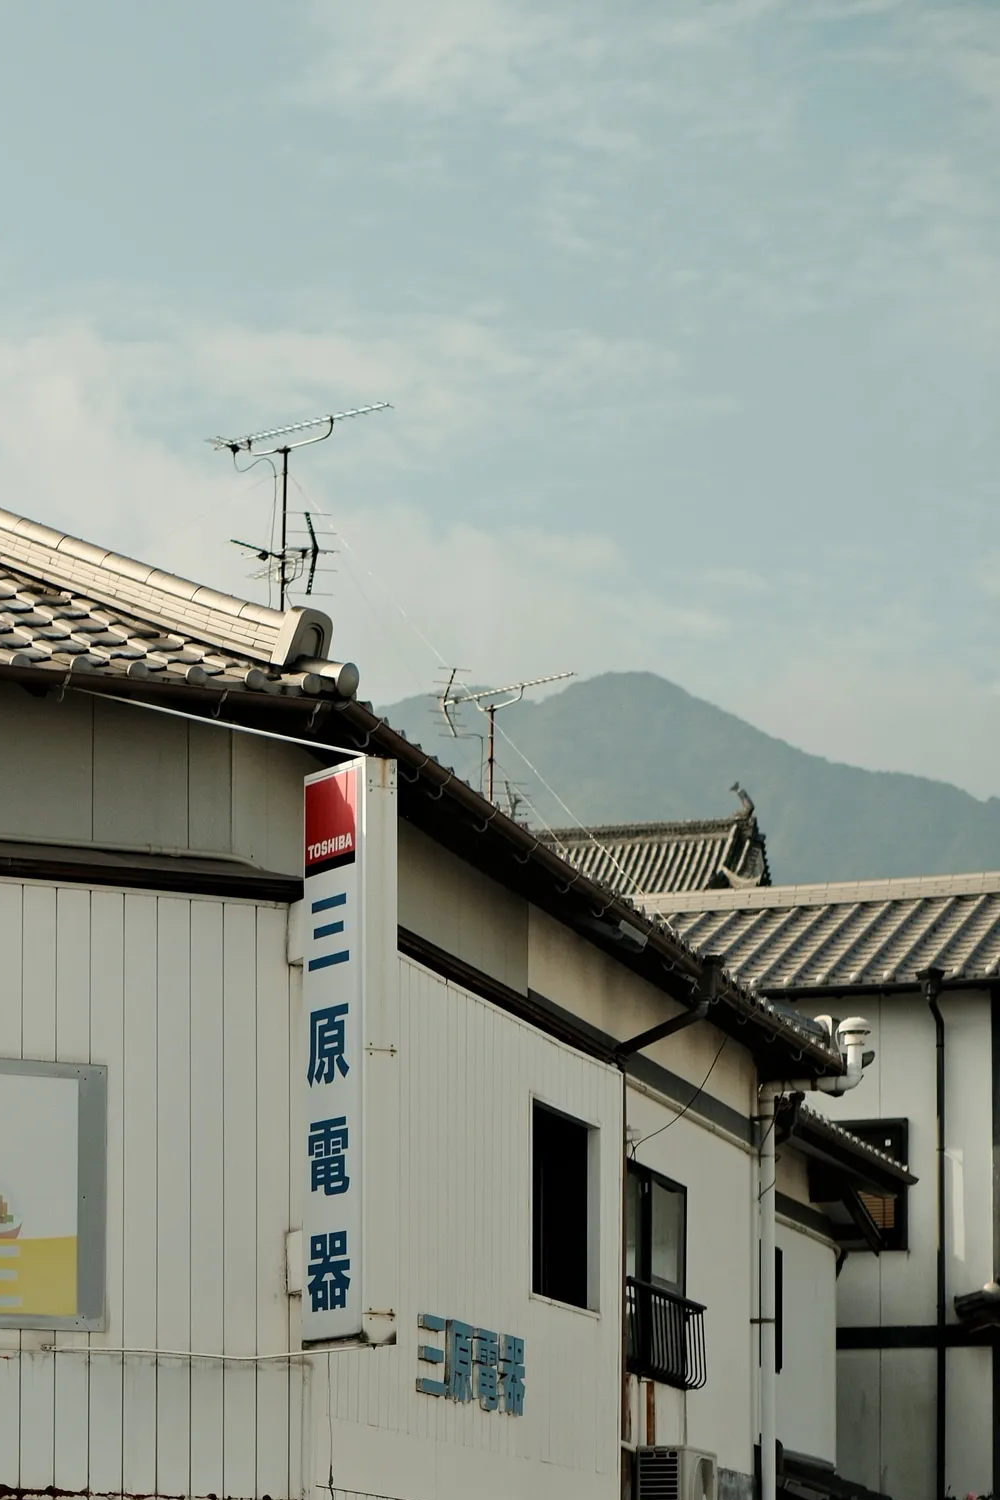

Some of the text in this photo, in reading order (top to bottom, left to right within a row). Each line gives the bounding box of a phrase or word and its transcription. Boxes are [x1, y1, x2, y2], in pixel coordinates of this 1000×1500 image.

[307, 832, 353, 861] TOSHIBA
[306, 893, 351, 1313] 三原電器
[416, 1313, 526, 1418] 三原電器
